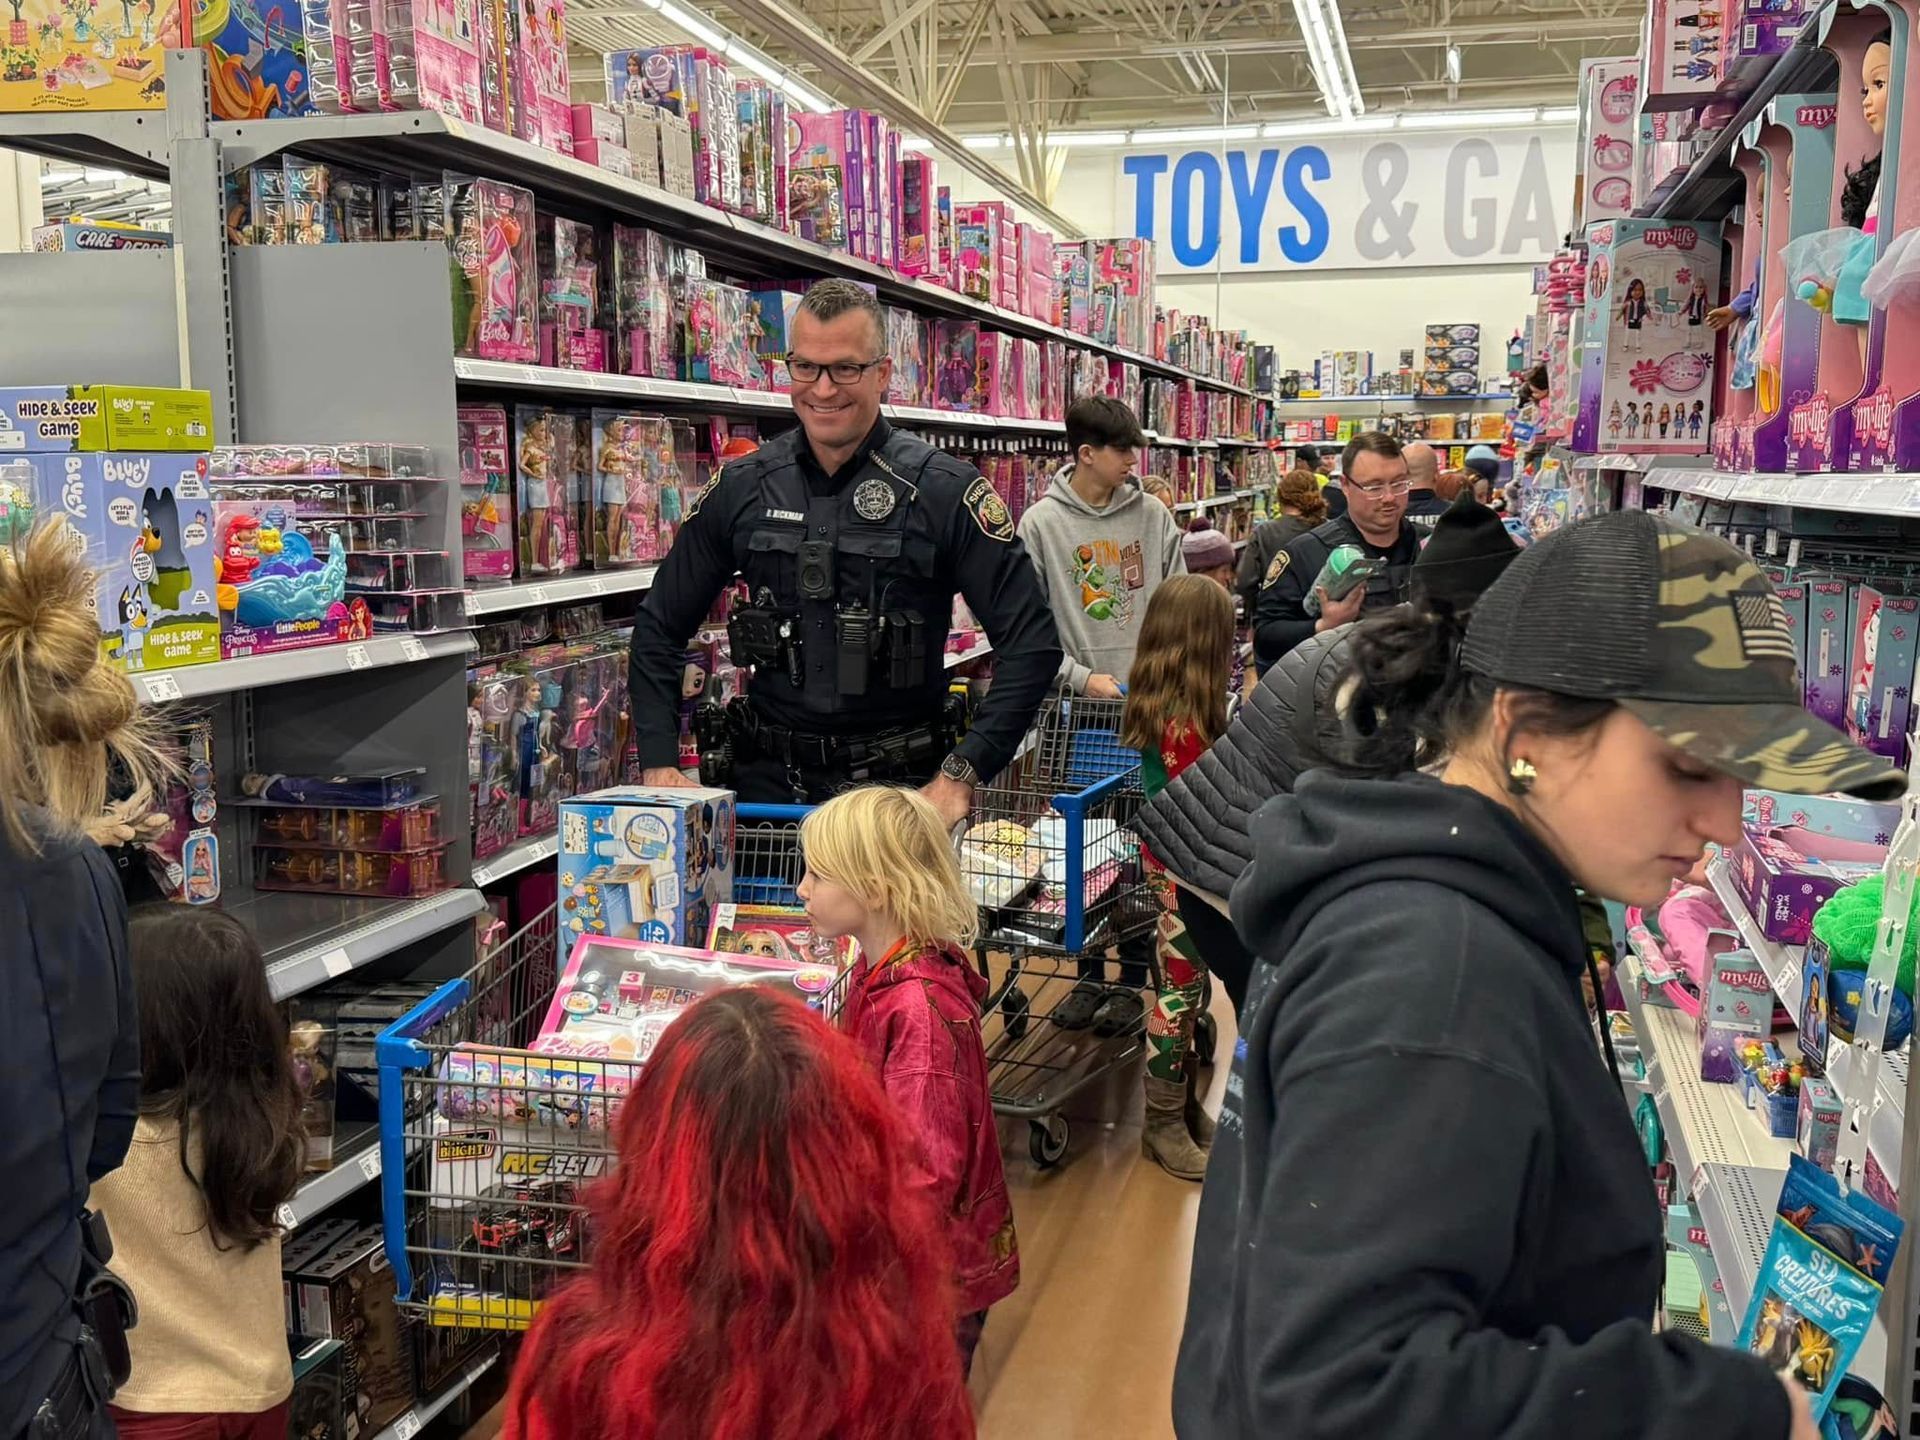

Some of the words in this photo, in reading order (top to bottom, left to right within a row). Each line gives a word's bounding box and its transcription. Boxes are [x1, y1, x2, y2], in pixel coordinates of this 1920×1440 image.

[1124, 145, 1331, 267] TOYS
[1354, 141, 1419, 261] &
[77, 230, 118, 248] CARE
[51, 402, 61, 416] &
[1120, 540, 1141, 560] VOLS
[172, 632, 180, 643] &
[625, 972, 640, 983] 3
[1809, 1250, 1839, 1282] SEA
[1774, 1254, 1852, 1320] CREATURES
